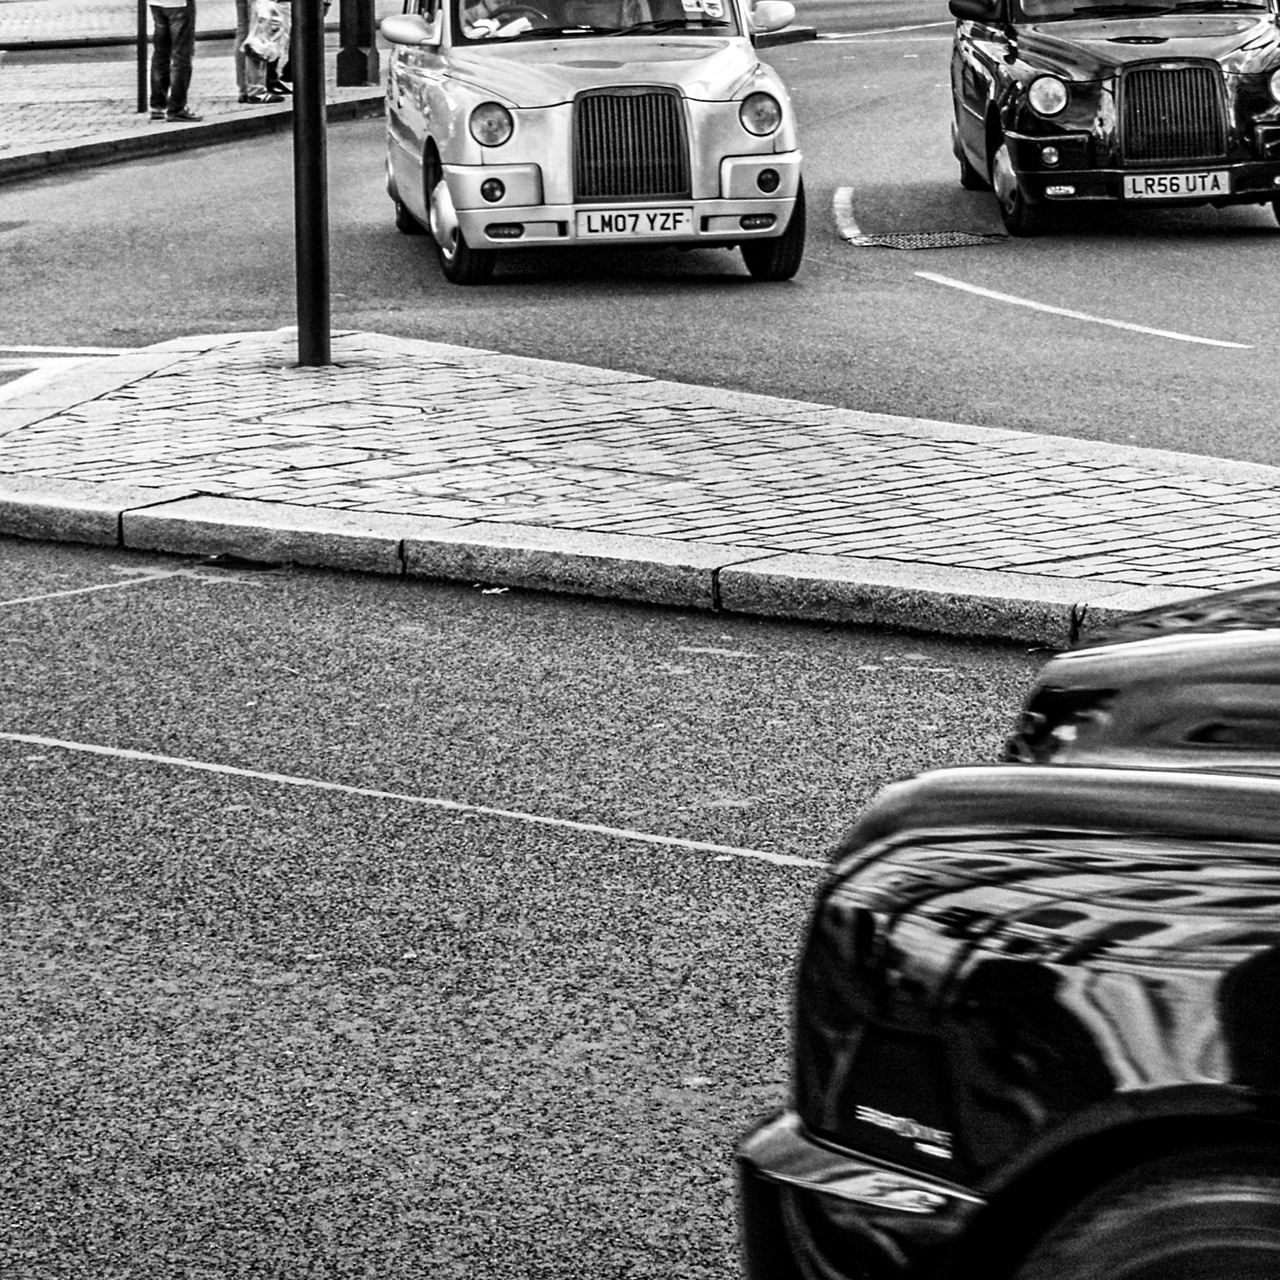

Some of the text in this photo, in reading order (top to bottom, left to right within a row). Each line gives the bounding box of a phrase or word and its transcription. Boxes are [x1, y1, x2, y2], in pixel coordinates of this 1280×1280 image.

[1132, 174, 1221, 195] LR56 UTA
[587, 212, 684, 233] LM07 YZF
